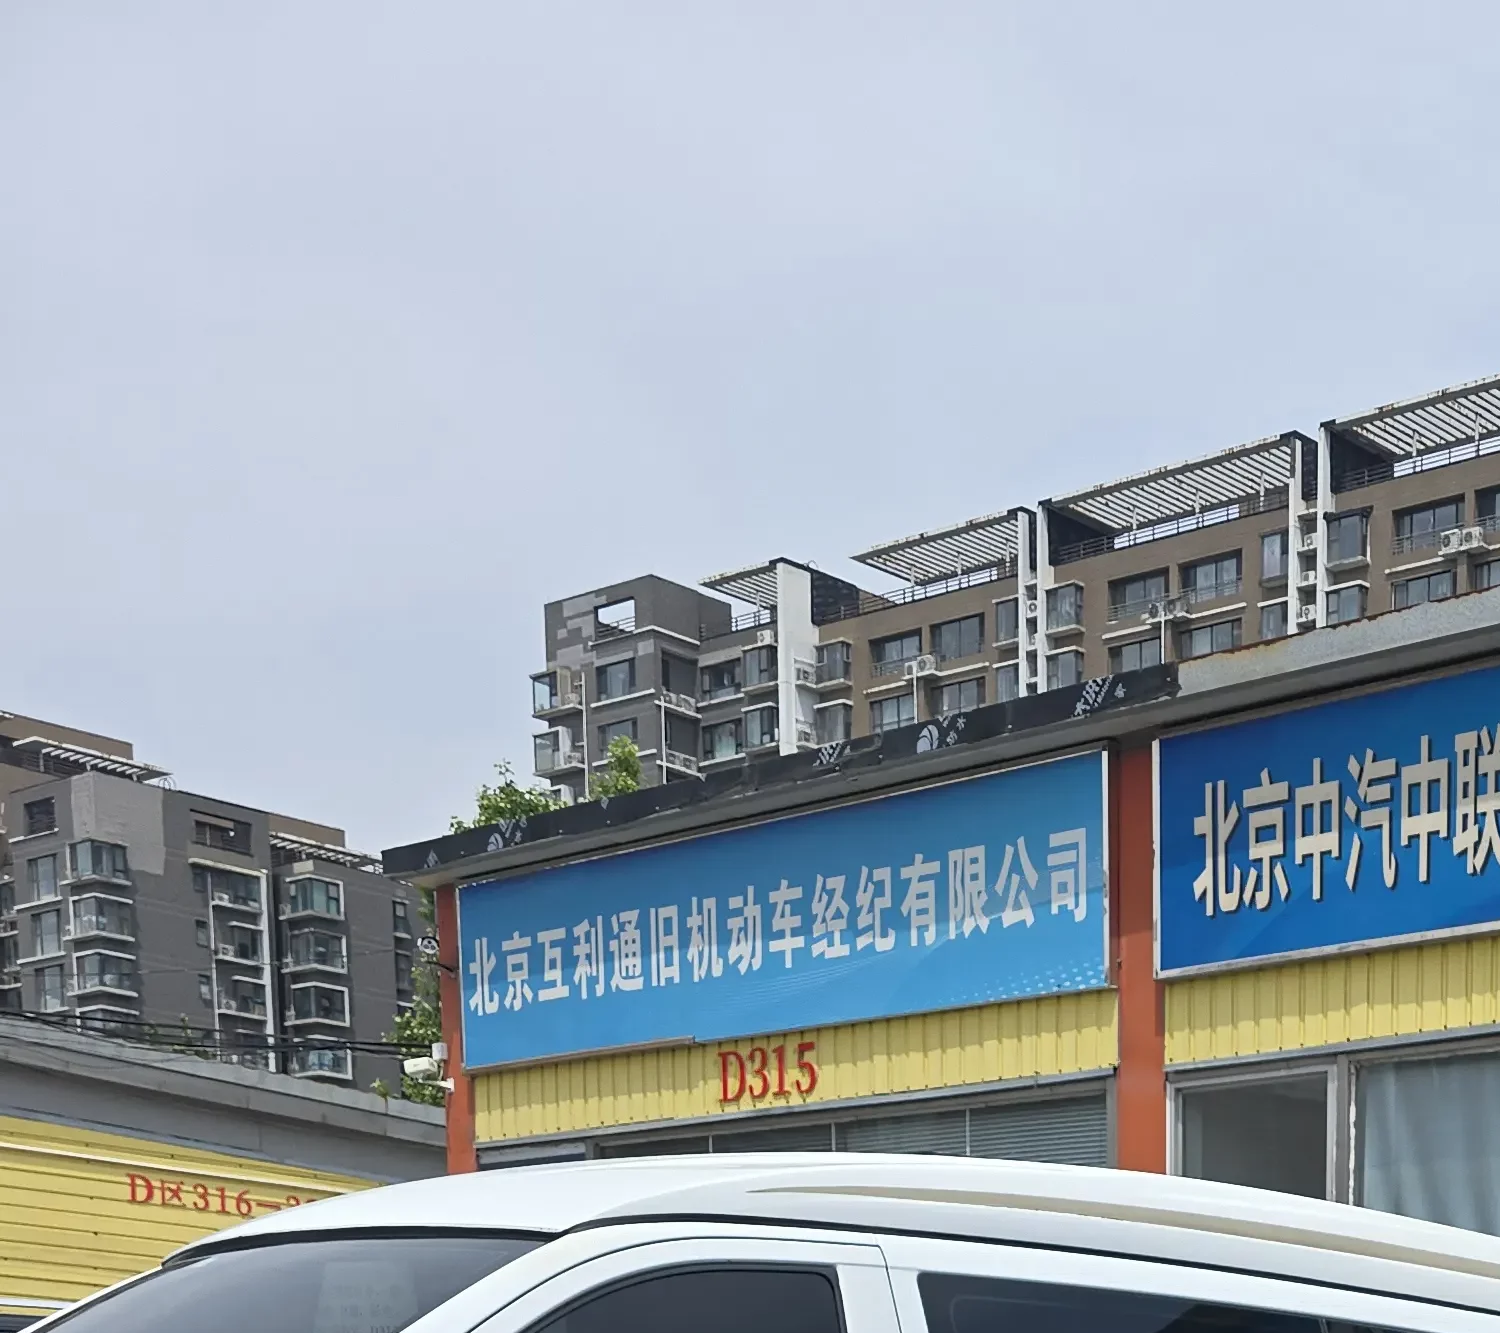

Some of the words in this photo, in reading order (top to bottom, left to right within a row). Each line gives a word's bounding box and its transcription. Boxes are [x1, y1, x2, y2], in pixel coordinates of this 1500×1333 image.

[468, 827, 1088, 1016] 北京互利通旧机动车经纪有限公司
[718, 1040, 820, 1104] D315
